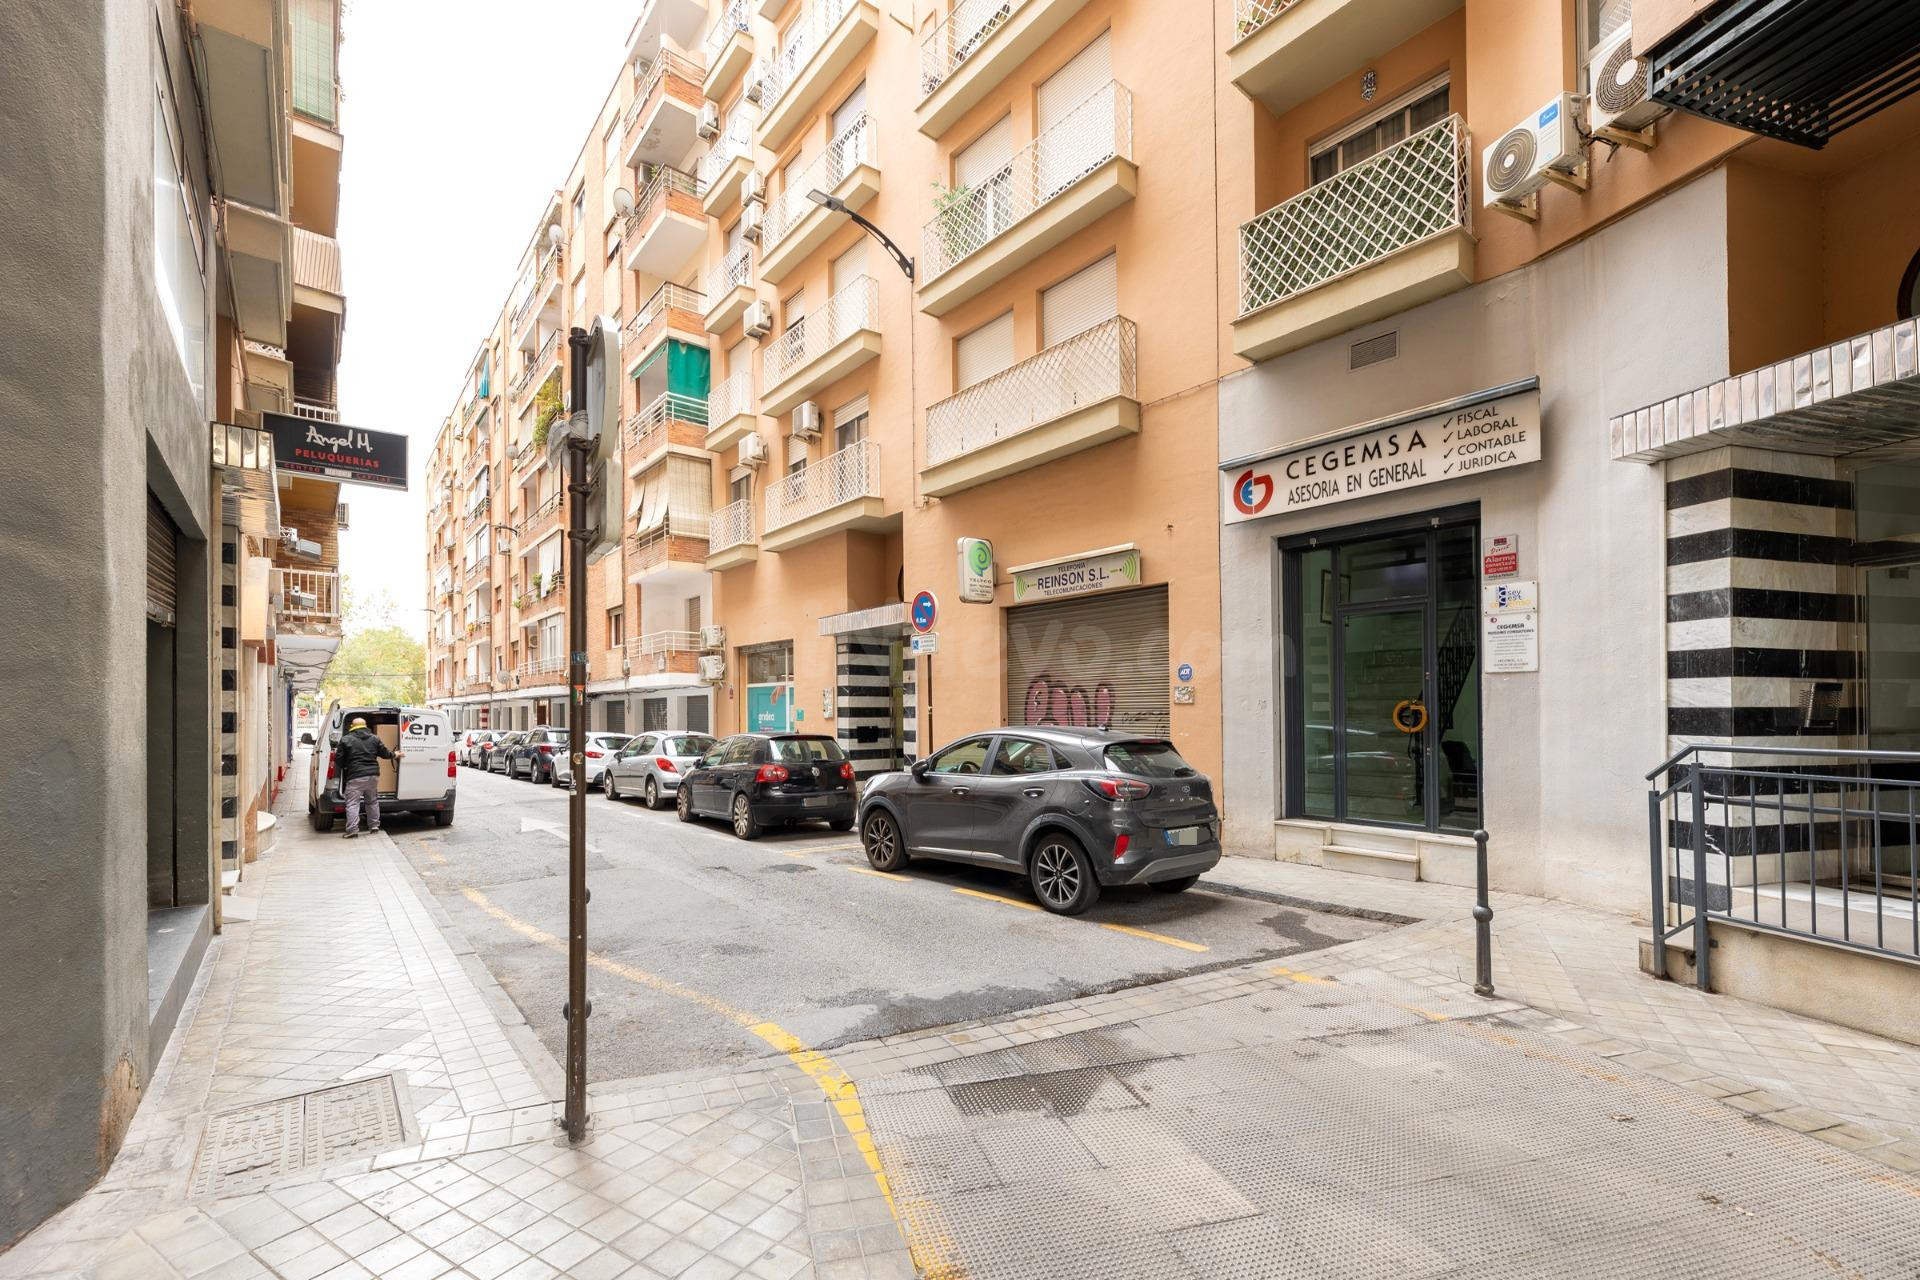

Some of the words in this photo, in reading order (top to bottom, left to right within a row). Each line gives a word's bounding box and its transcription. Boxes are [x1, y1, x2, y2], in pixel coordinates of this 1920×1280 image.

[1457, 407, 1498, 425] FISCAL
[306, 425, 353, 453] Angel
[1457, 417, 1518, 441] LABORAL
[1286, 430, 1427, 480] CEGEMSA
[1457, 431, 1526, 456] CONTABLE
[295, 448, 381, 469] PELUQUERIAS
[1458, 450, 1517, 472] JURIDICA
[1287, 479, 1340, 506] ASESORIA
[1347, 472, 1362, 493] EN
[1368, 458, 1427, 487] GENERAL
[1485, 554, 1516, 563] Alarma
[1037, 571, 1085, 590] REINSON
[1088, 567, 1110, 582] S.L.
[1044, 582, 1103, 597] TELECOMUNICACIONES
